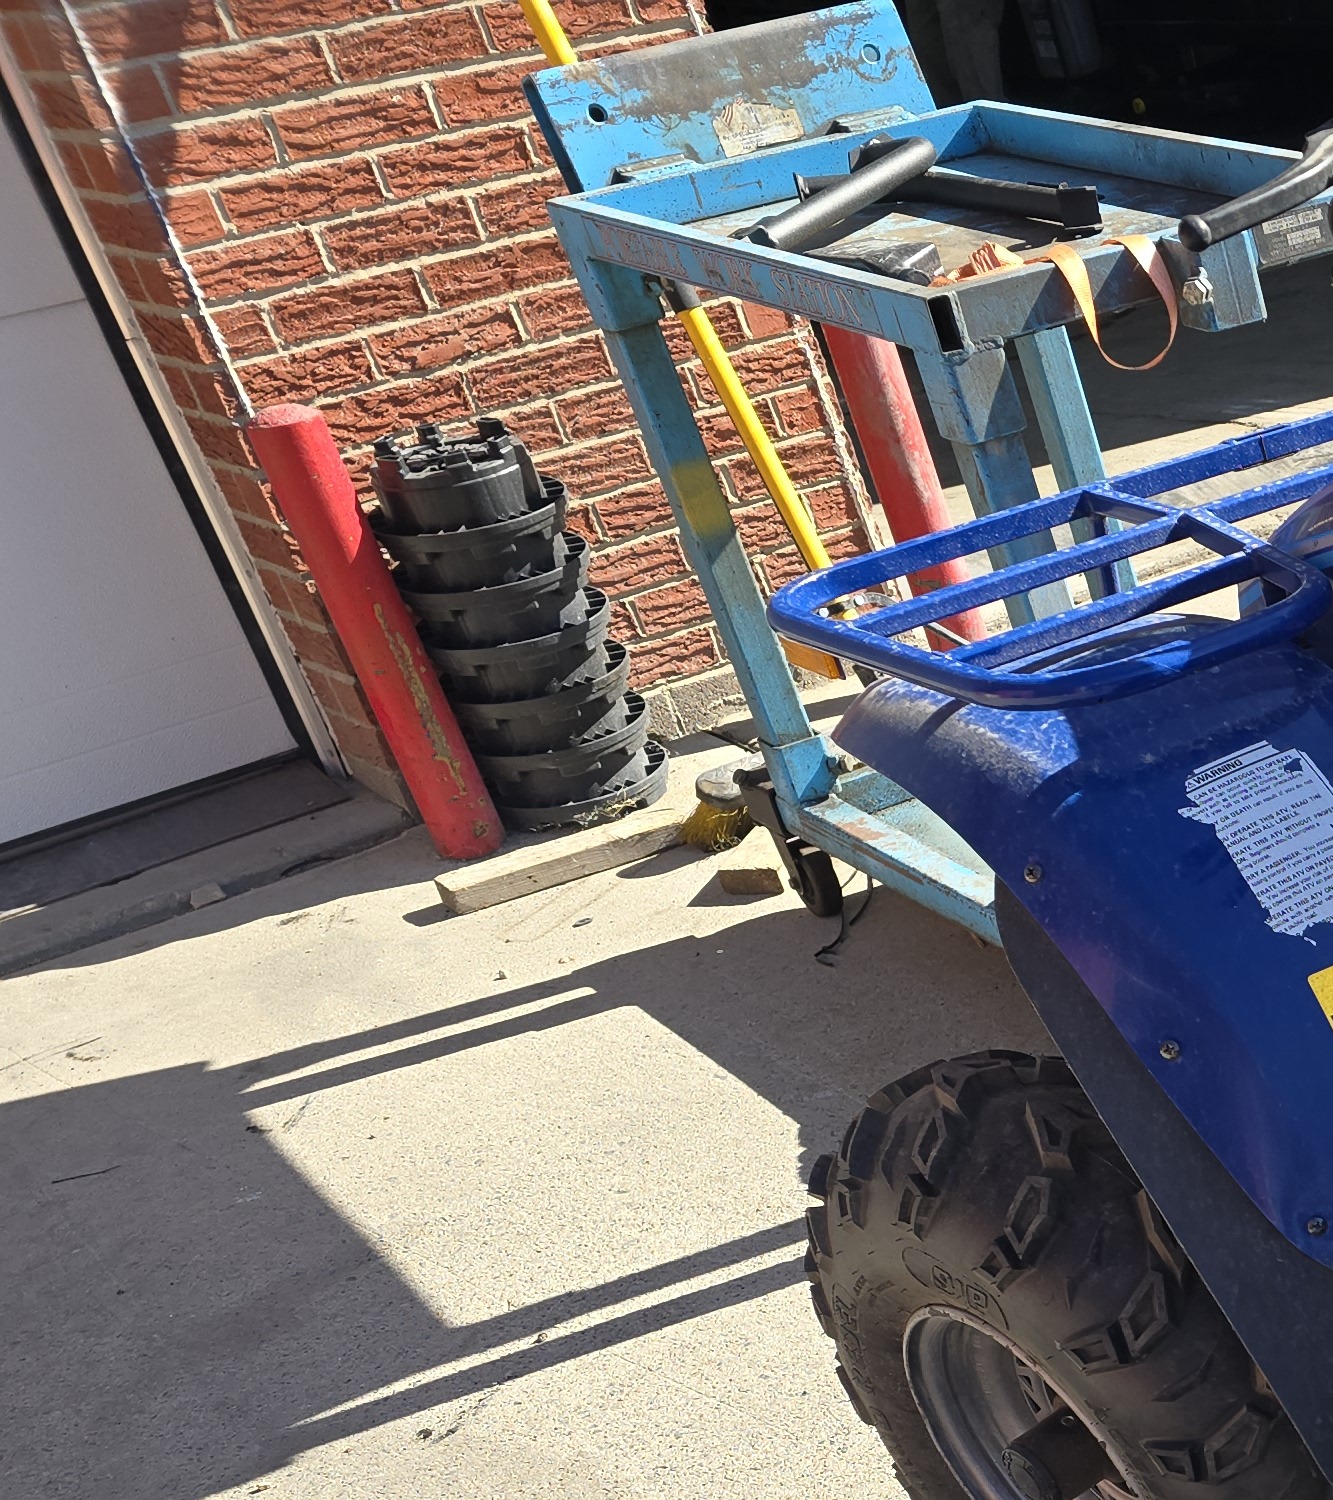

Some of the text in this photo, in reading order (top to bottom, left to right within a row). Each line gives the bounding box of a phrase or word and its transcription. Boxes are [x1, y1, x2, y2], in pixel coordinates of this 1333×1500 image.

[1192, 759, 1242, 783] WARNING
[1217, 769, 1255, 788] HAZARDOUS
[1226, 836, 1248, 848] ANUAL
[1262, 821, 1275, 830] ALL
[1229, 821, 1258, 838] OPERATE
[1231, 845, 1251, 858] ERATE
[1284, 816, 1311, 831] WITHOUT
[1245, 870, 1258, 881] RRY
[1256, 883, 1276, 897] ERATE
[1292, 868, 1304, 879] ATV
[1310, 890, 1322, 900] ATV
[1324, 885, 1333, 893] ON
